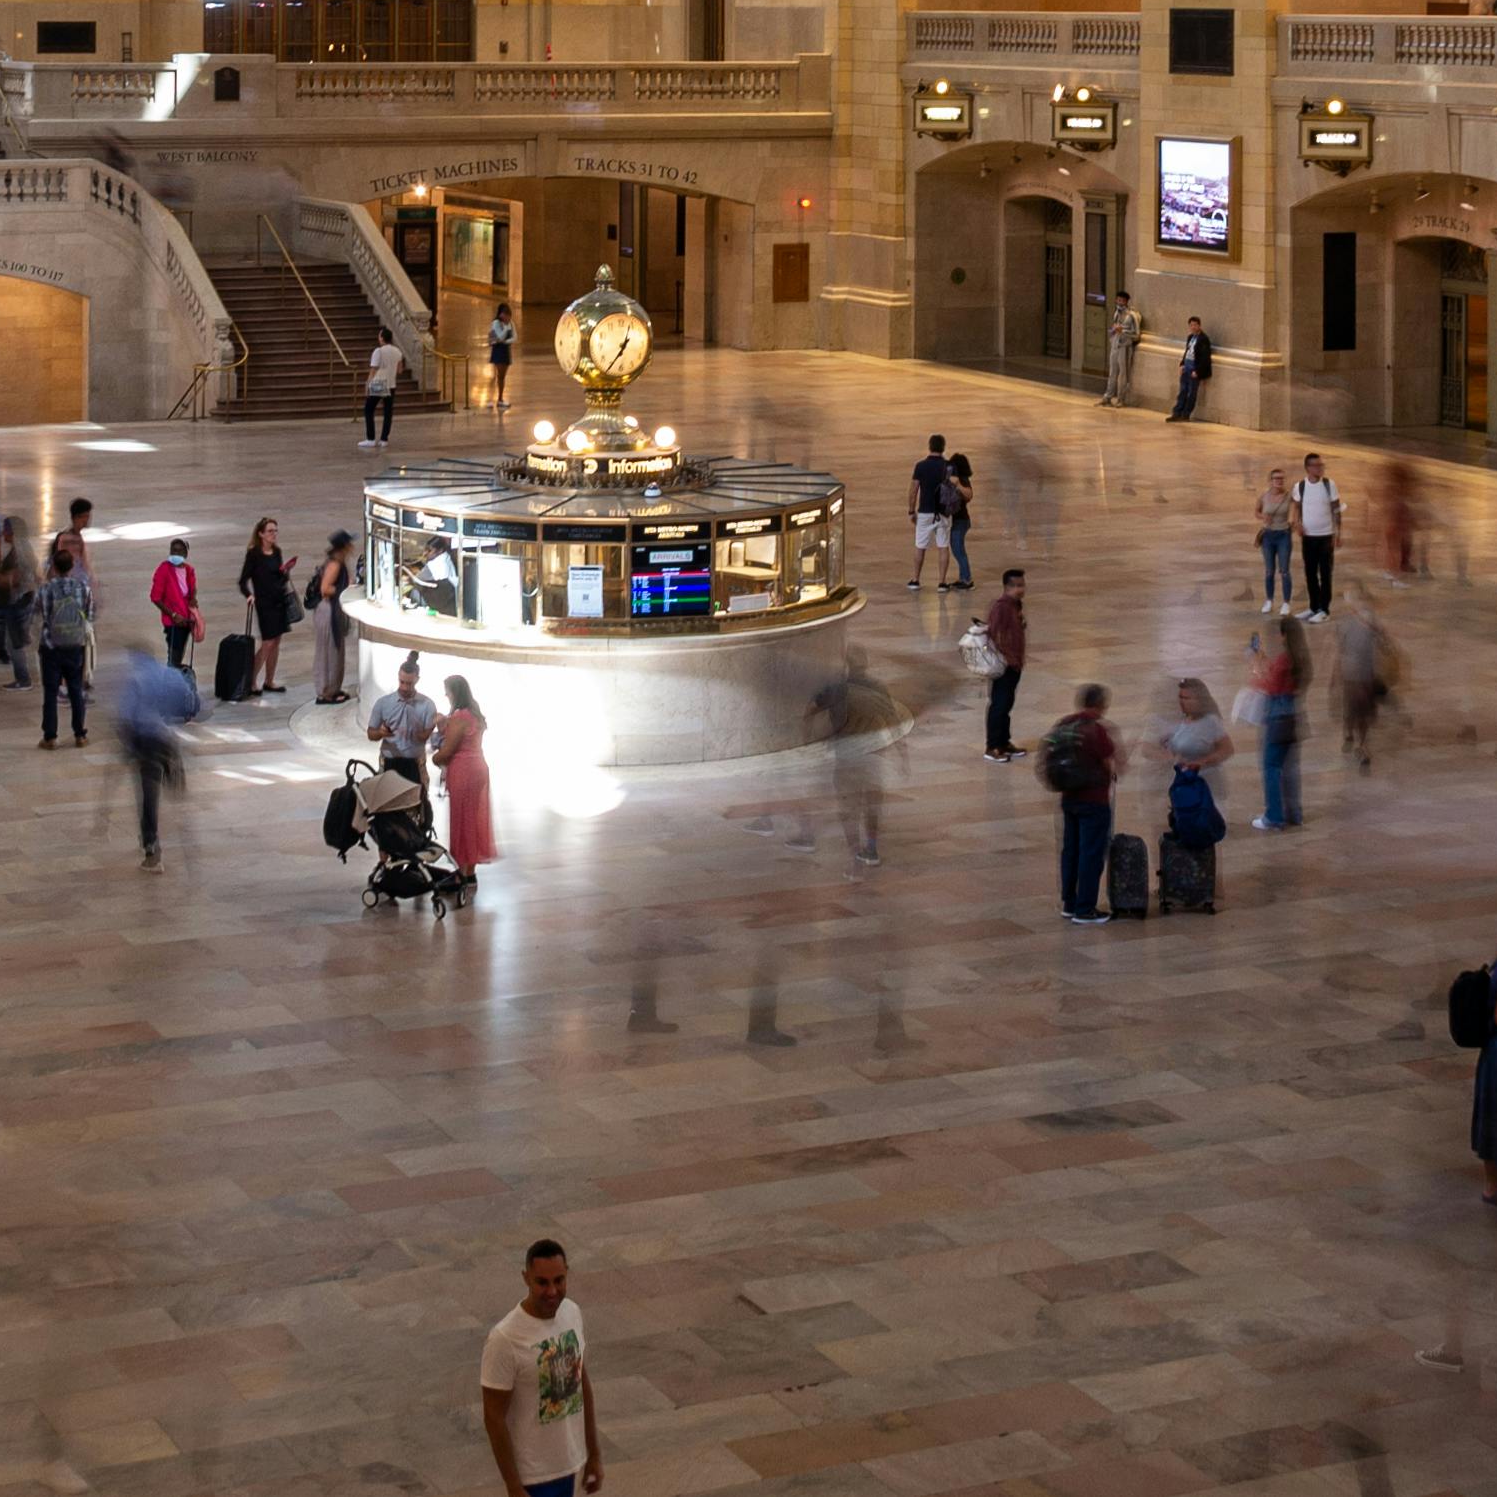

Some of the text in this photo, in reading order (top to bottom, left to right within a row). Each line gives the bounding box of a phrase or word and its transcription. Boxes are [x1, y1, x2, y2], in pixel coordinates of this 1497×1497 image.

[156, 150, 258, 163] WEST BALCONY
[369, 157, 519, 192] TICKET MACHINES
[574, 157, 698, 184] TRACKS 31 TO 42
[1425, 215, 1457, 230] TRACK
[9, 261, 28, 273] 100
[30, 265, 47, 277] TO
[48, 270, 64, 281] 117
[608, 456, 674, 474] Information
